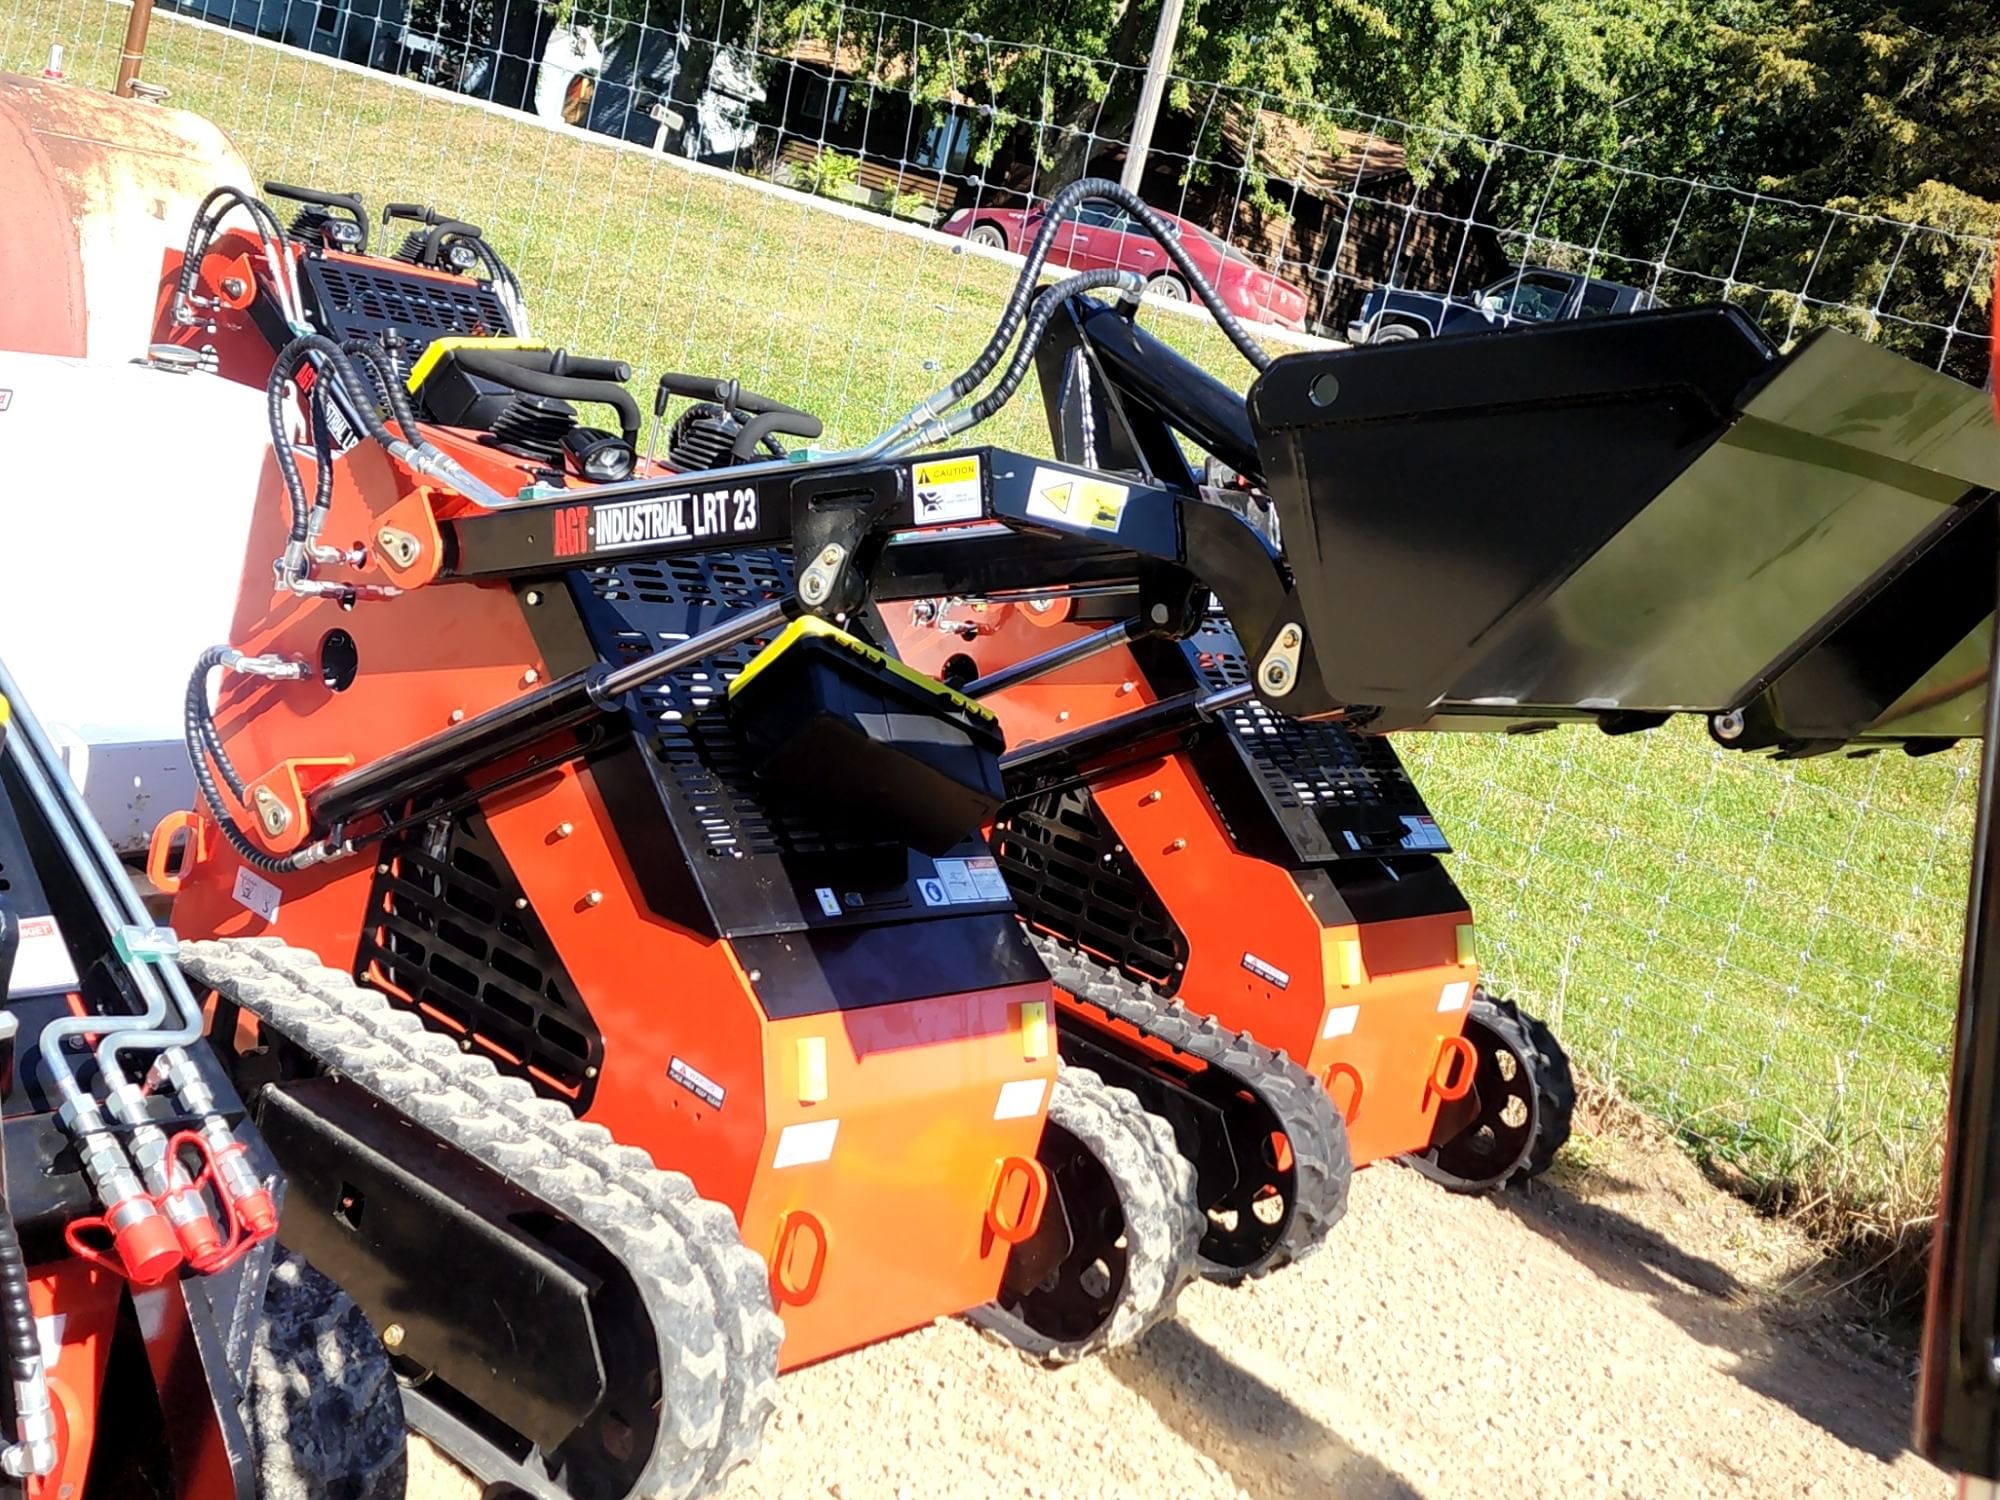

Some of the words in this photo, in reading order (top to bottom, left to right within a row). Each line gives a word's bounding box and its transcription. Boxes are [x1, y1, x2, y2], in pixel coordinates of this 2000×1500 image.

[933, 465, 975, 478] CAUTION
[554, 506, 588, 557] AGT
[595, 499, 686, 545] INDUSTRIAL
[692, 490, 729, 536] LRT
[733, 487, 757, 531] 23
